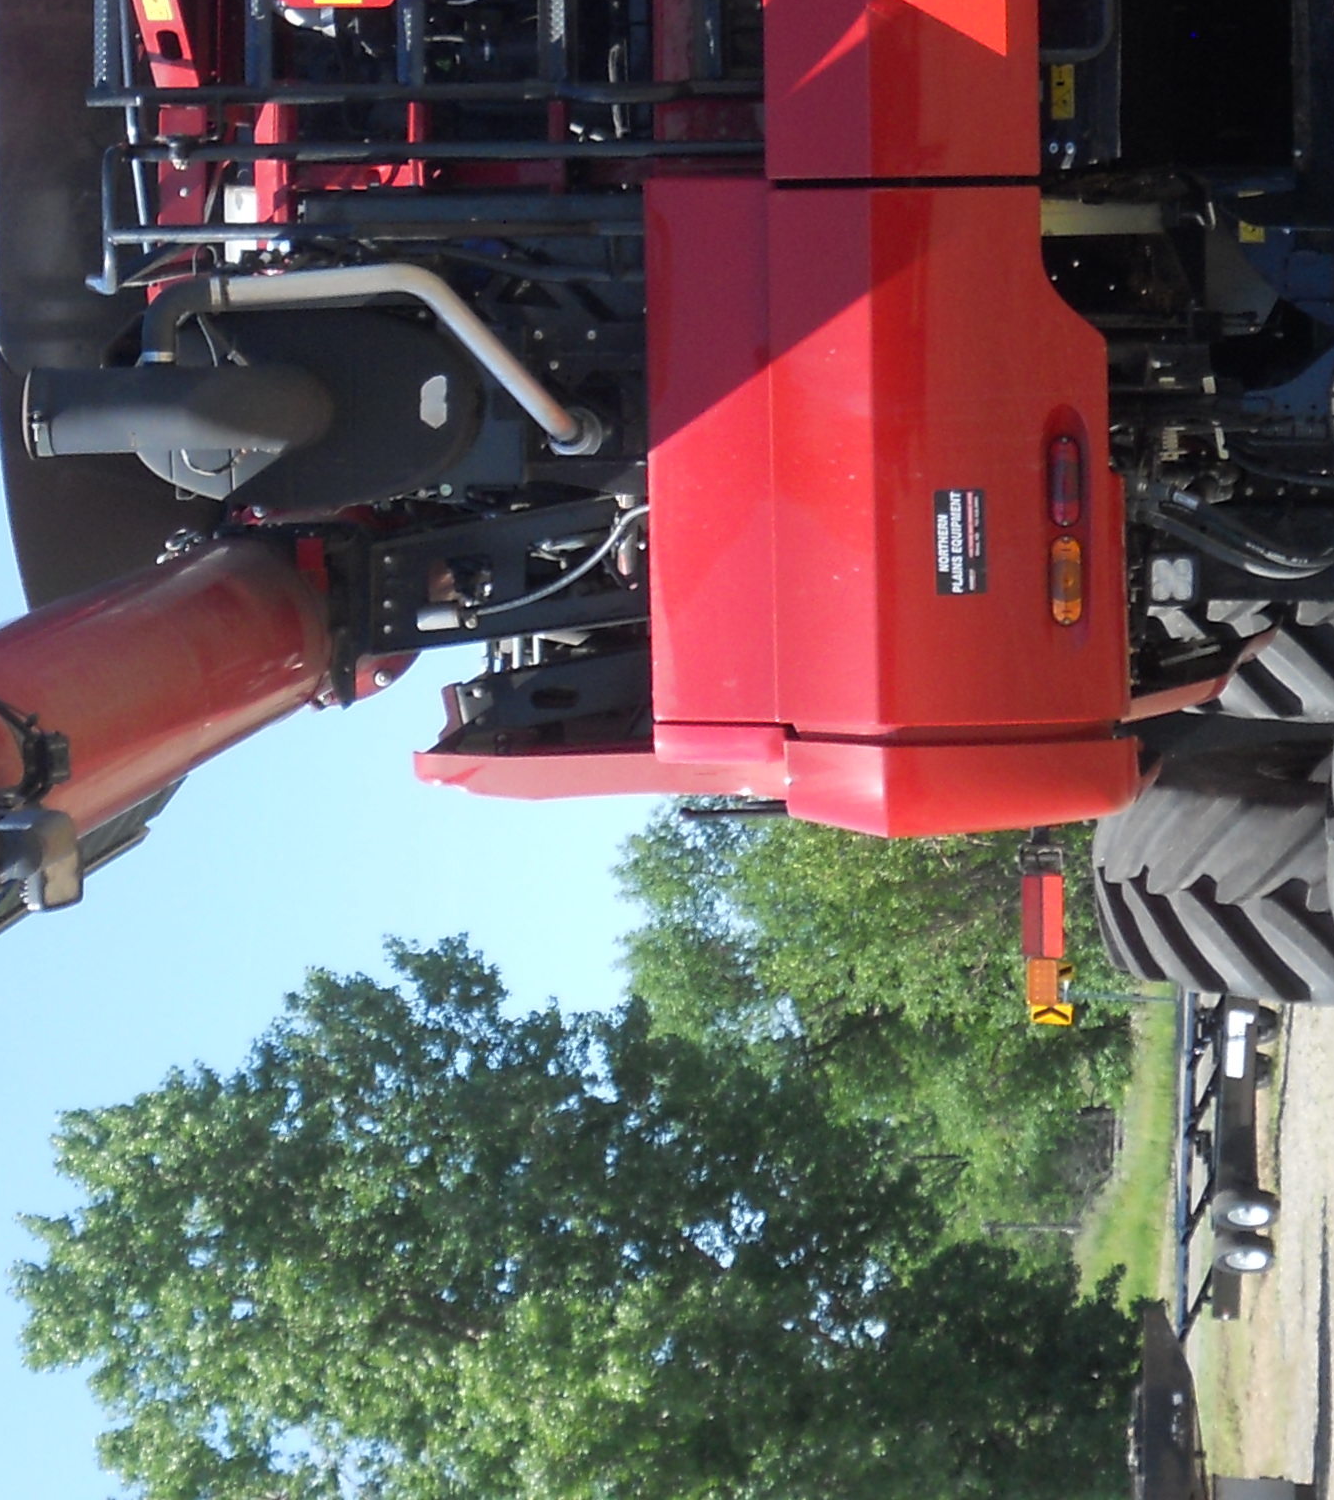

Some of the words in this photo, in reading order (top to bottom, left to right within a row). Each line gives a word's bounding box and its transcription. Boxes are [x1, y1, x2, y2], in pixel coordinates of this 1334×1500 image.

[936, 513, 949, 572] NORTHERN
[950, 491, 963, 554] EQUIPMENT
[951, 555, 964, 594] PLAINS
